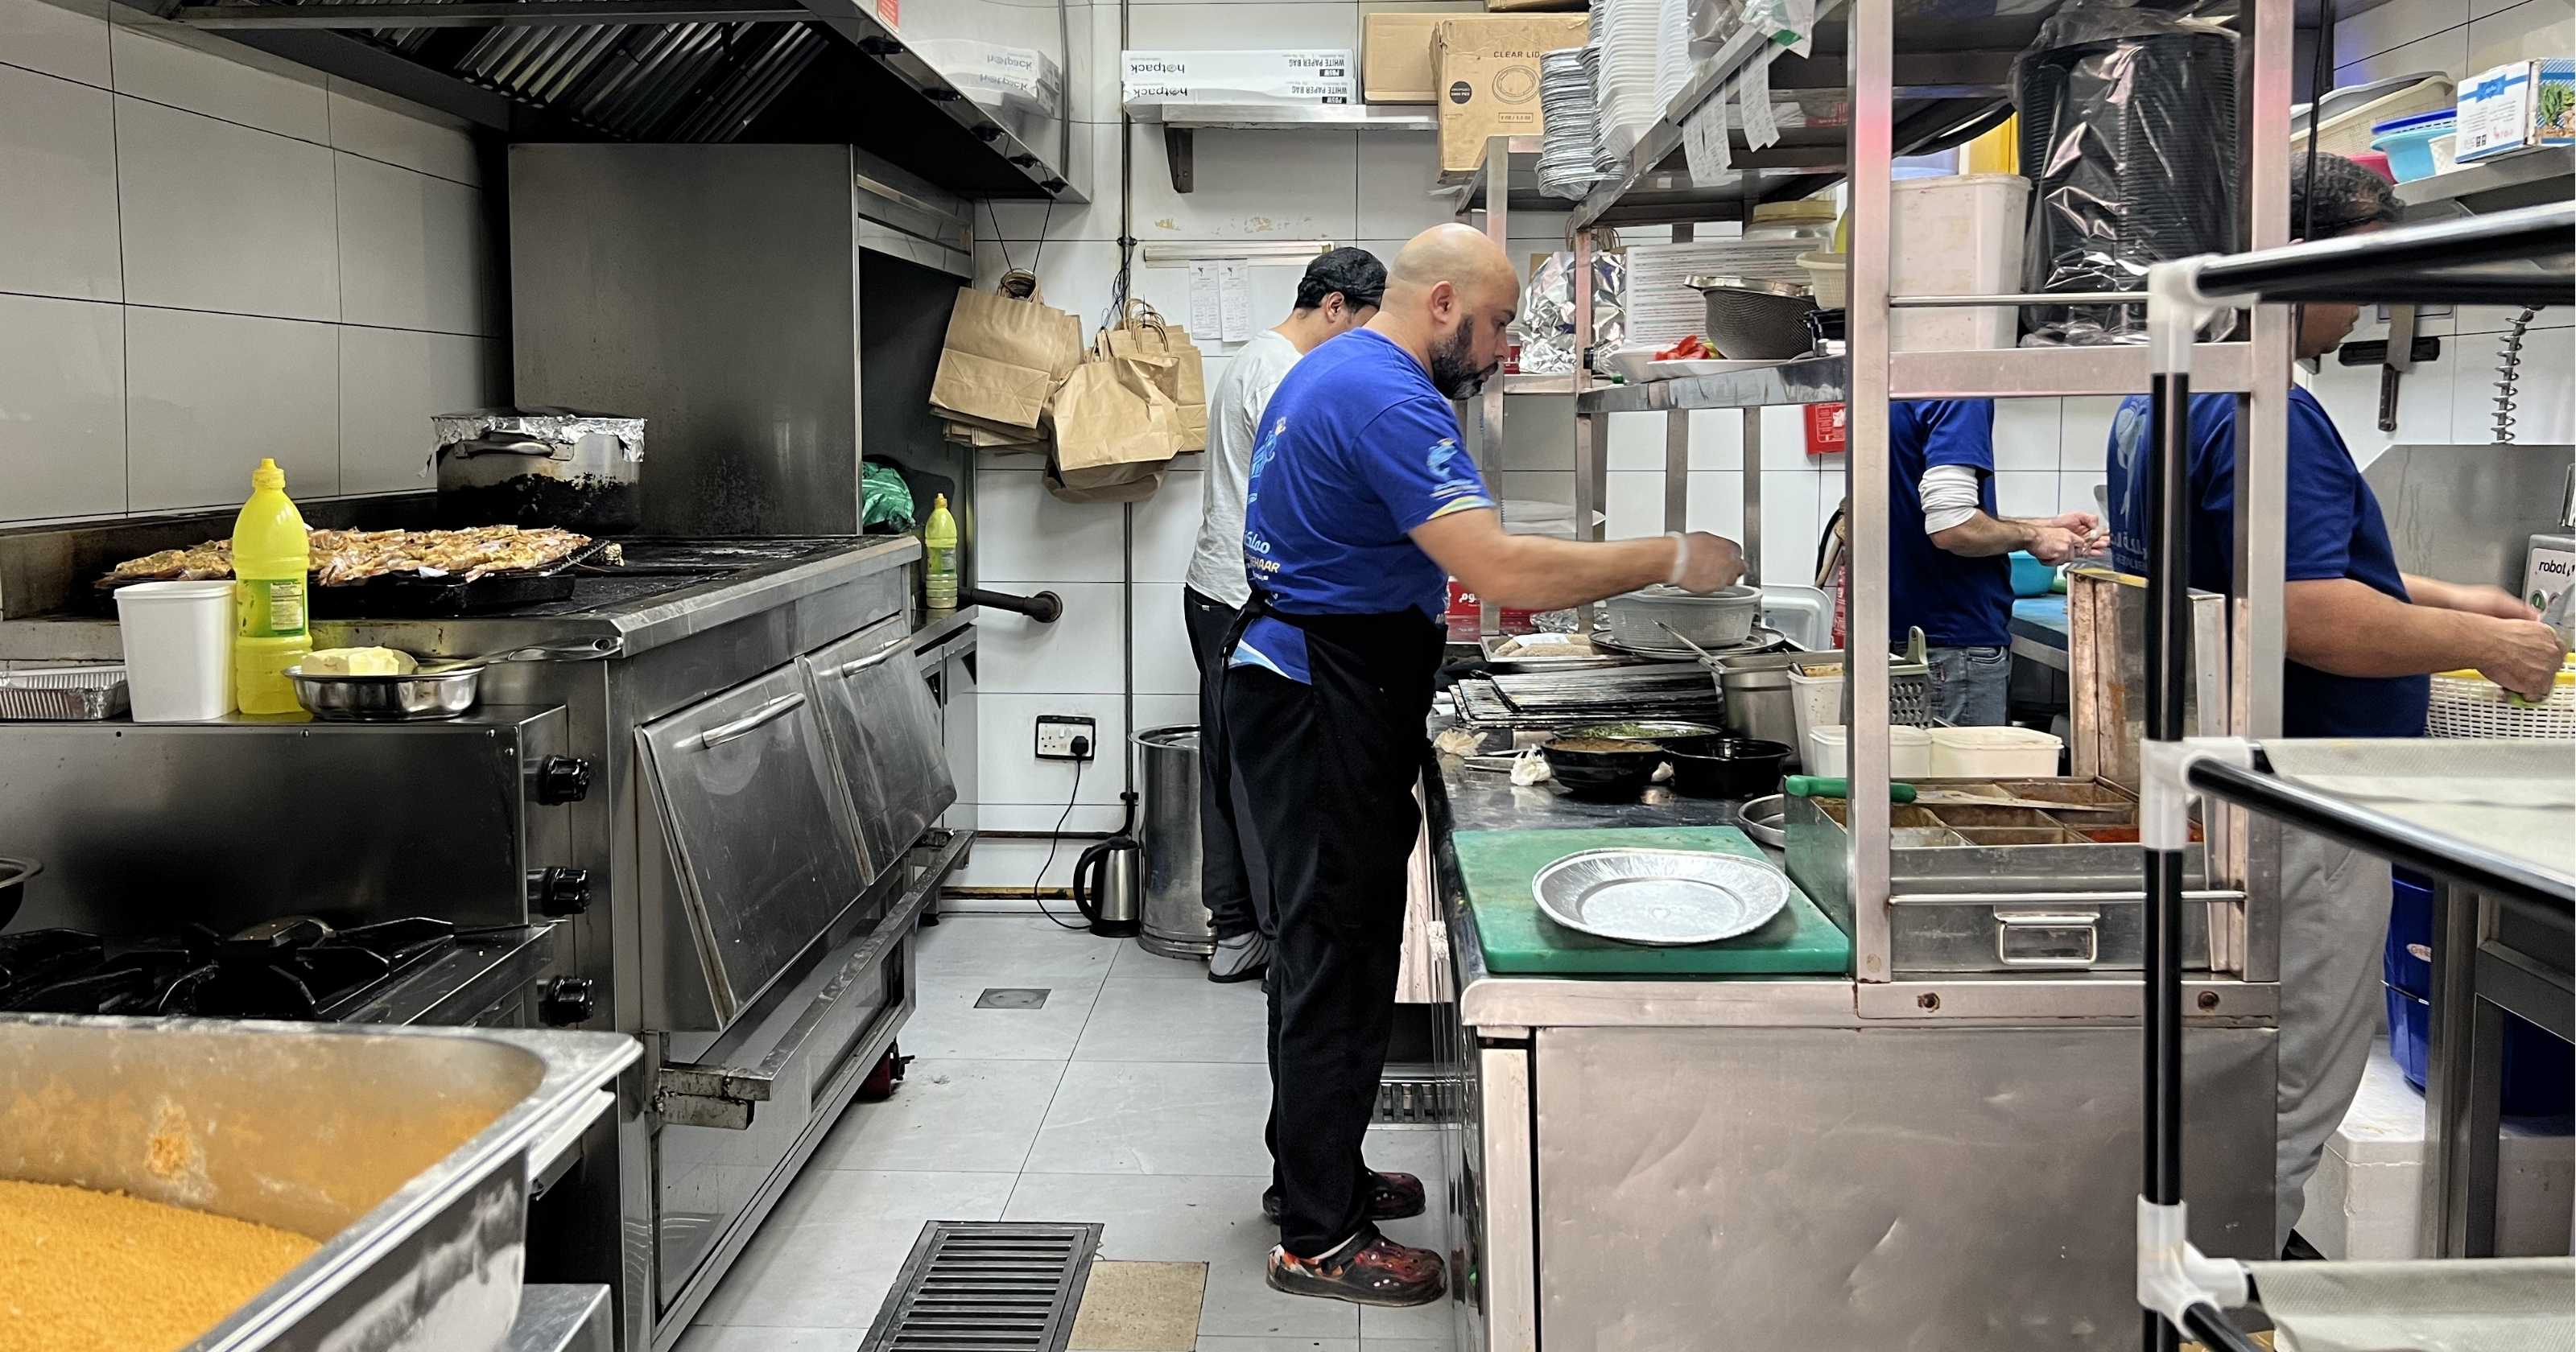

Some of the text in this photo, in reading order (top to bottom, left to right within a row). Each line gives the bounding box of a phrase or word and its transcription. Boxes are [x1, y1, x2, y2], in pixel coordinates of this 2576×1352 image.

[1130, 62, 1185, 73] hotpack
[1289, 59, 1344, 67] WHITE PAPER BAG
[1133, 87, 1188, 97] hotpack
[1291, 86, 1348, 94] WHITE PAPER BAG
